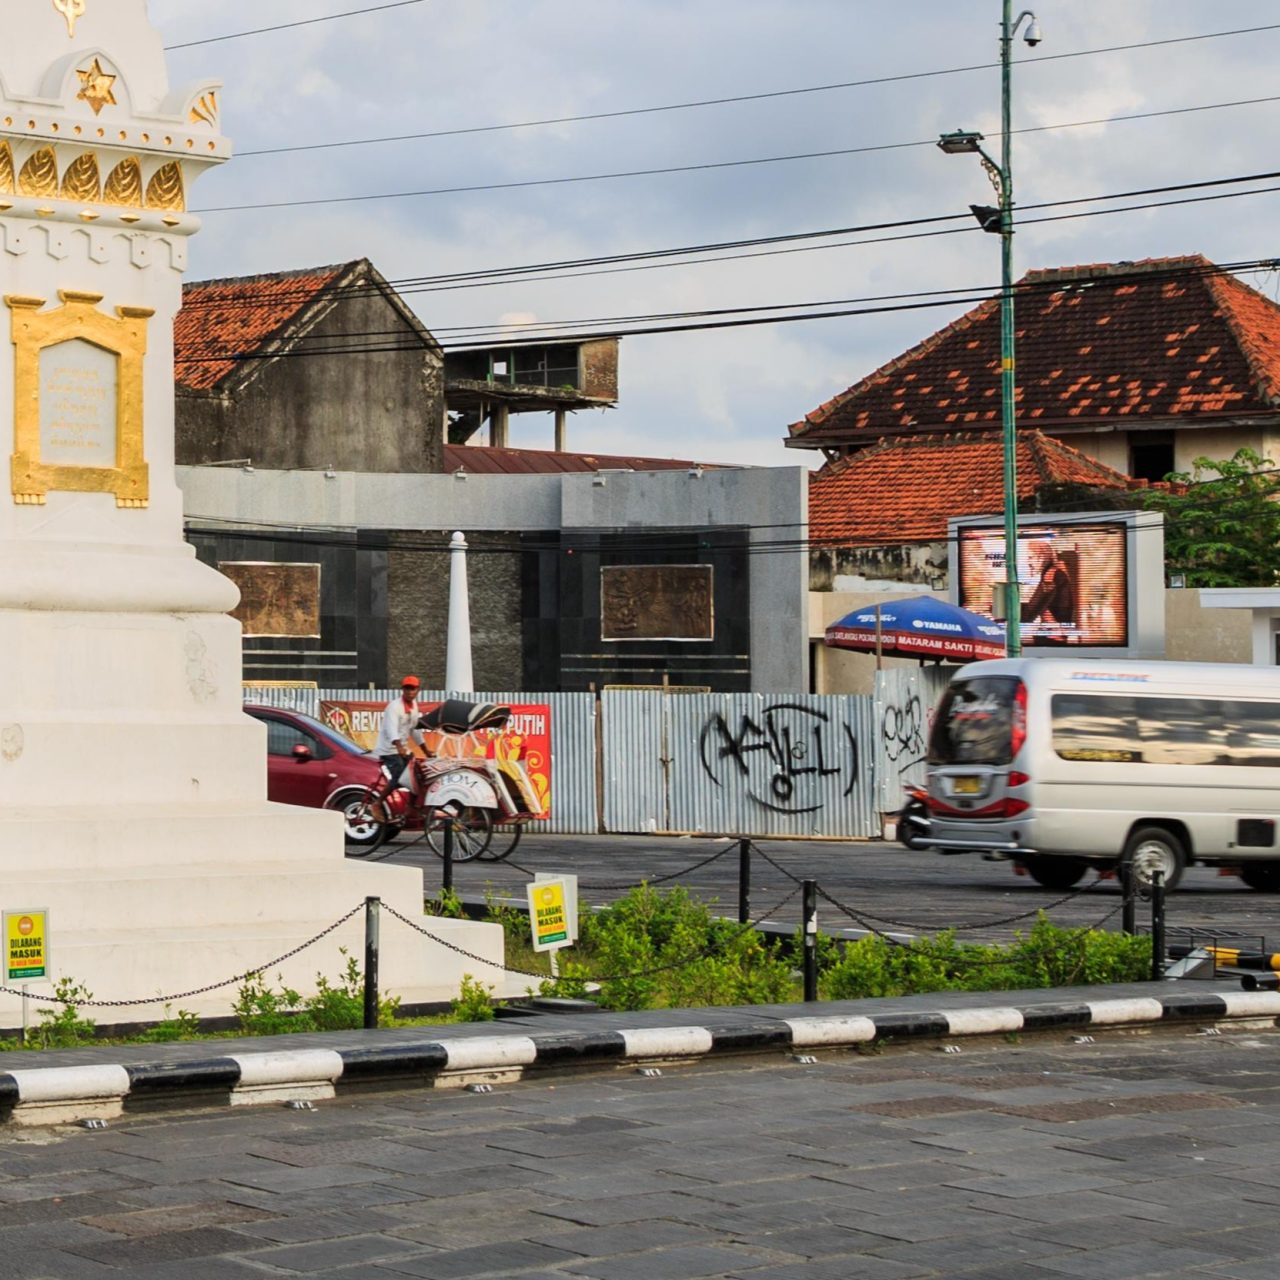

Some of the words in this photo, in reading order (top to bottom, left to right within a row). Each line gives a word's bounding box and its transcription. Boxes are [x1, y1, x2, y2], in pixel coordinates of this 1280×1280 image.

[923, 621, 962, 632] YAMAHA
[898, 635, 942, 649] MATARAM
[944, 641, 973, 652] SAKTI
[507, 714, 545, 736] PUTIH
[538, 916, 563, 927] MASUK
[10, 937, 42, 949] DILARANG
[10, 949, 42, 959] MASUK
